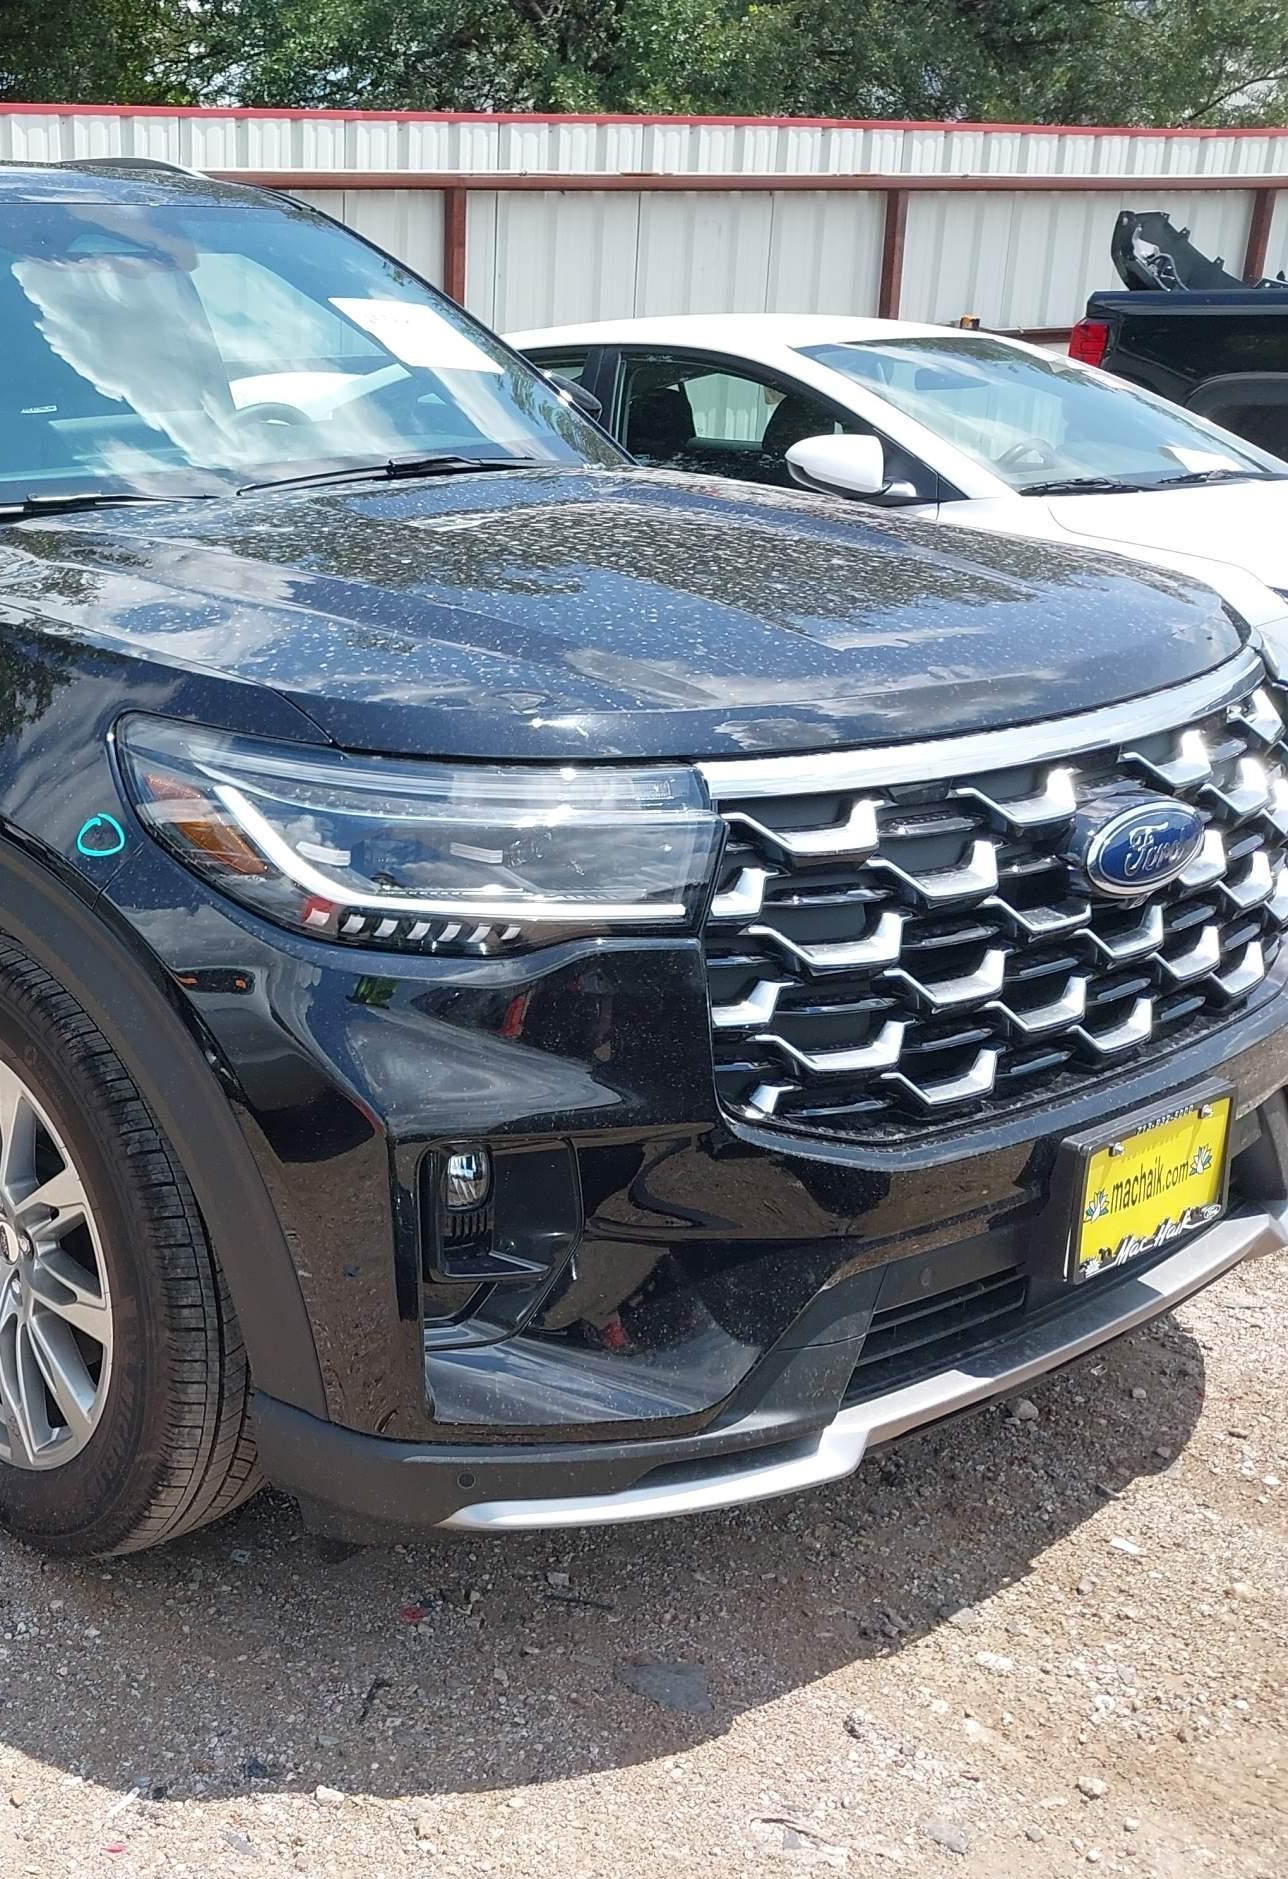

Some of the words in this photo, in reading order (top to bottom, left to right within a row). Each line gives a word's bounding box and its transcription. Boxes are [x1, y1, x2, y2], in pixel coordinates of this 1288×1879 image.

[1124, 821, 1185, 876] Ford
[1110, 1157, 1189, 1213] machaik.com
[1115, 1235, 1153, 1266] Mac
[1154, 1209, 1195, 1247] Haik
